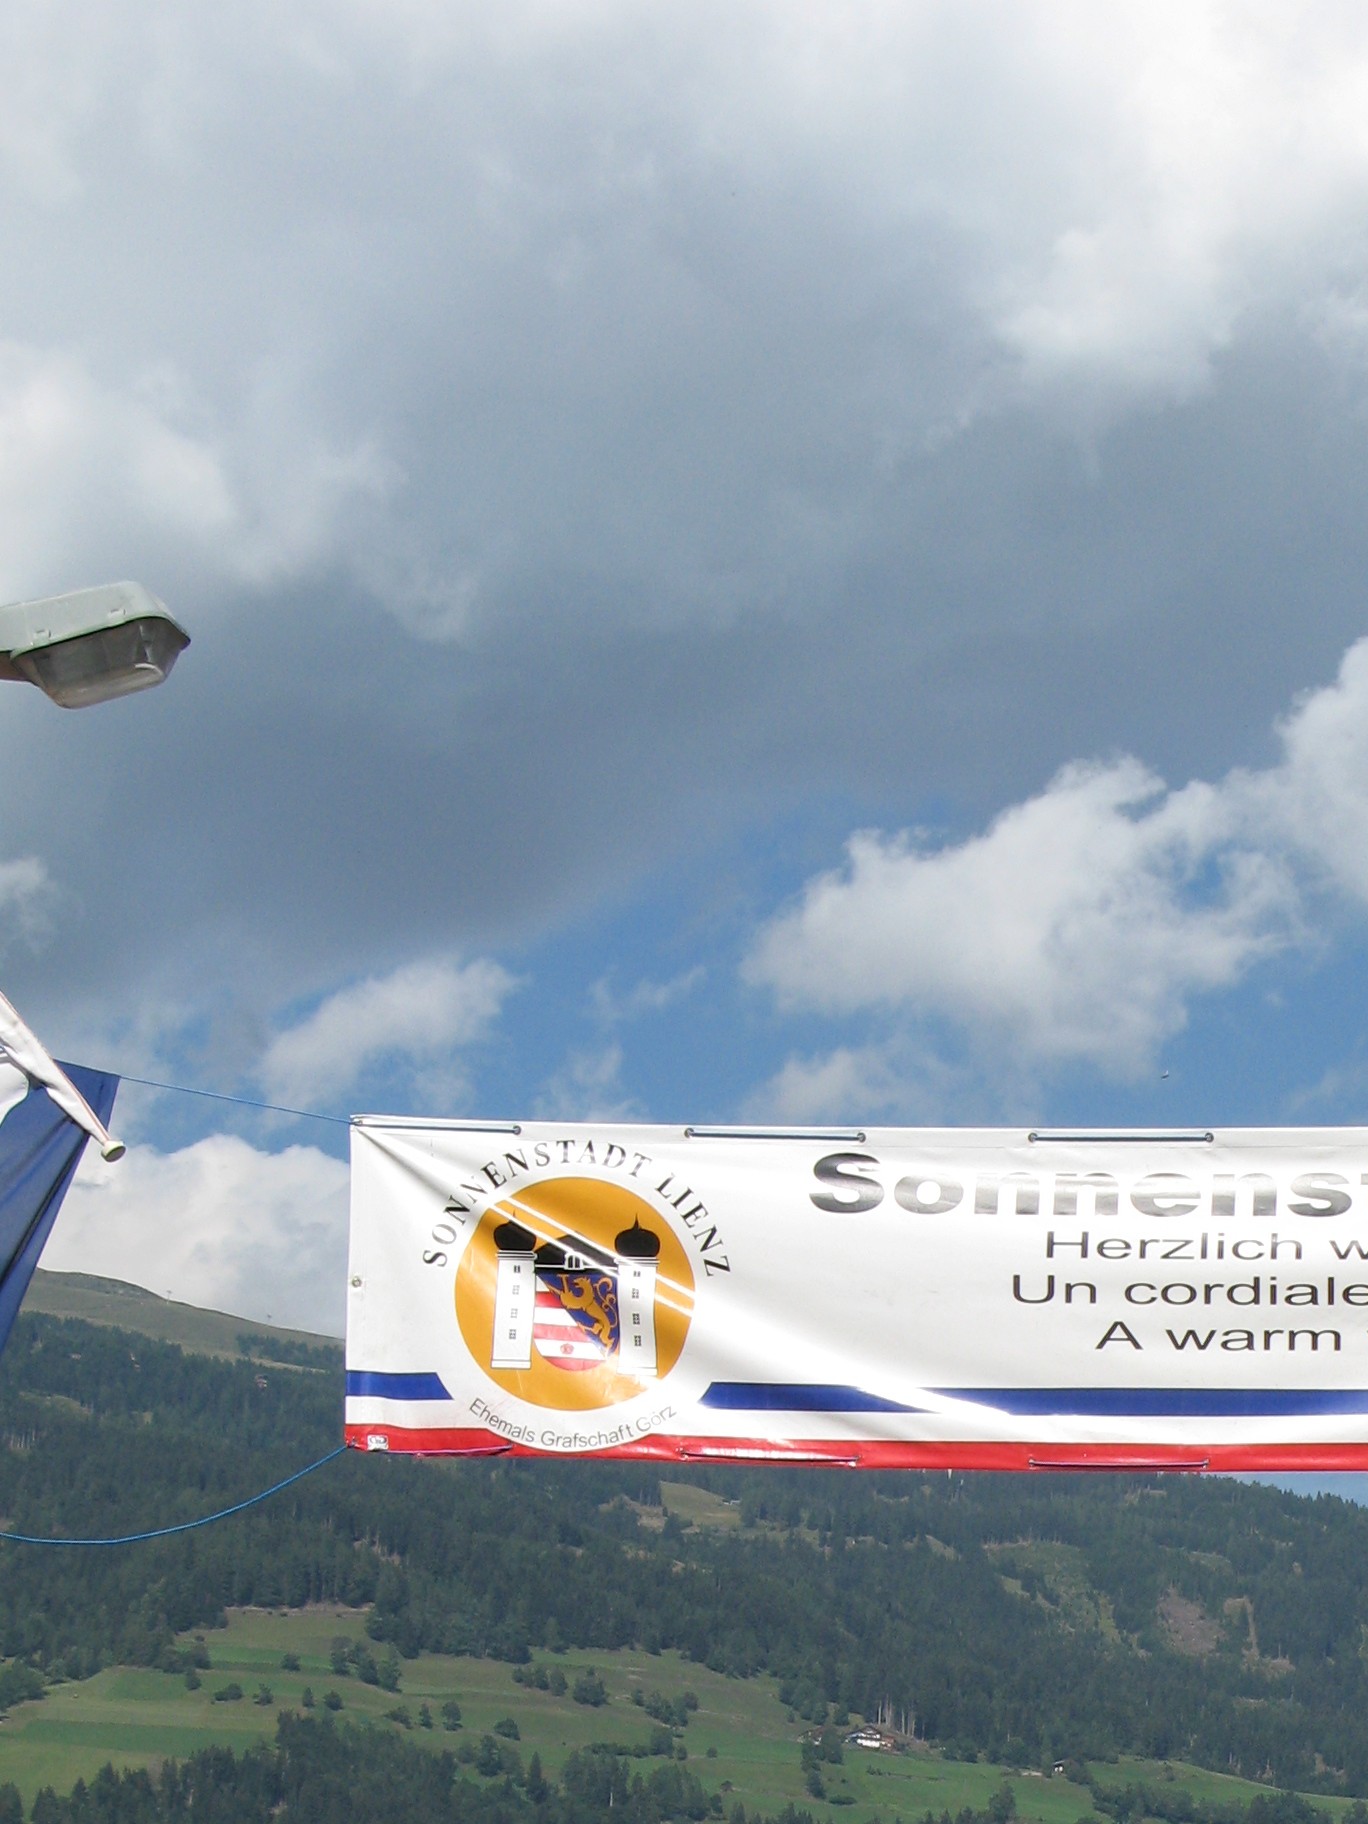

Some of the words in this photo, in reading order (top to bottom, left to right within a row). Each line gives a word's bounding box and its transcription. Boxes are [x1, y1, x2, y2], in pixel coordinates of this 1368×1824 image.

[422, 1139, 653, 1268] SONNENSTADT
[654, 1172, 731, 1277] LIENZ
[1045, 1231, 1303, 1261] Herzlich
[1011, 1274, 1098, 1304] Un
[1095, 1320, 1144, 1350] A
[1164, 1328, 1342, 1352] warm
[468, 1397, 536, 1443] Ehemals
[540, 1423, 635, 1449] Grafschaft
[635, 1405, 678, 1432] Görz
